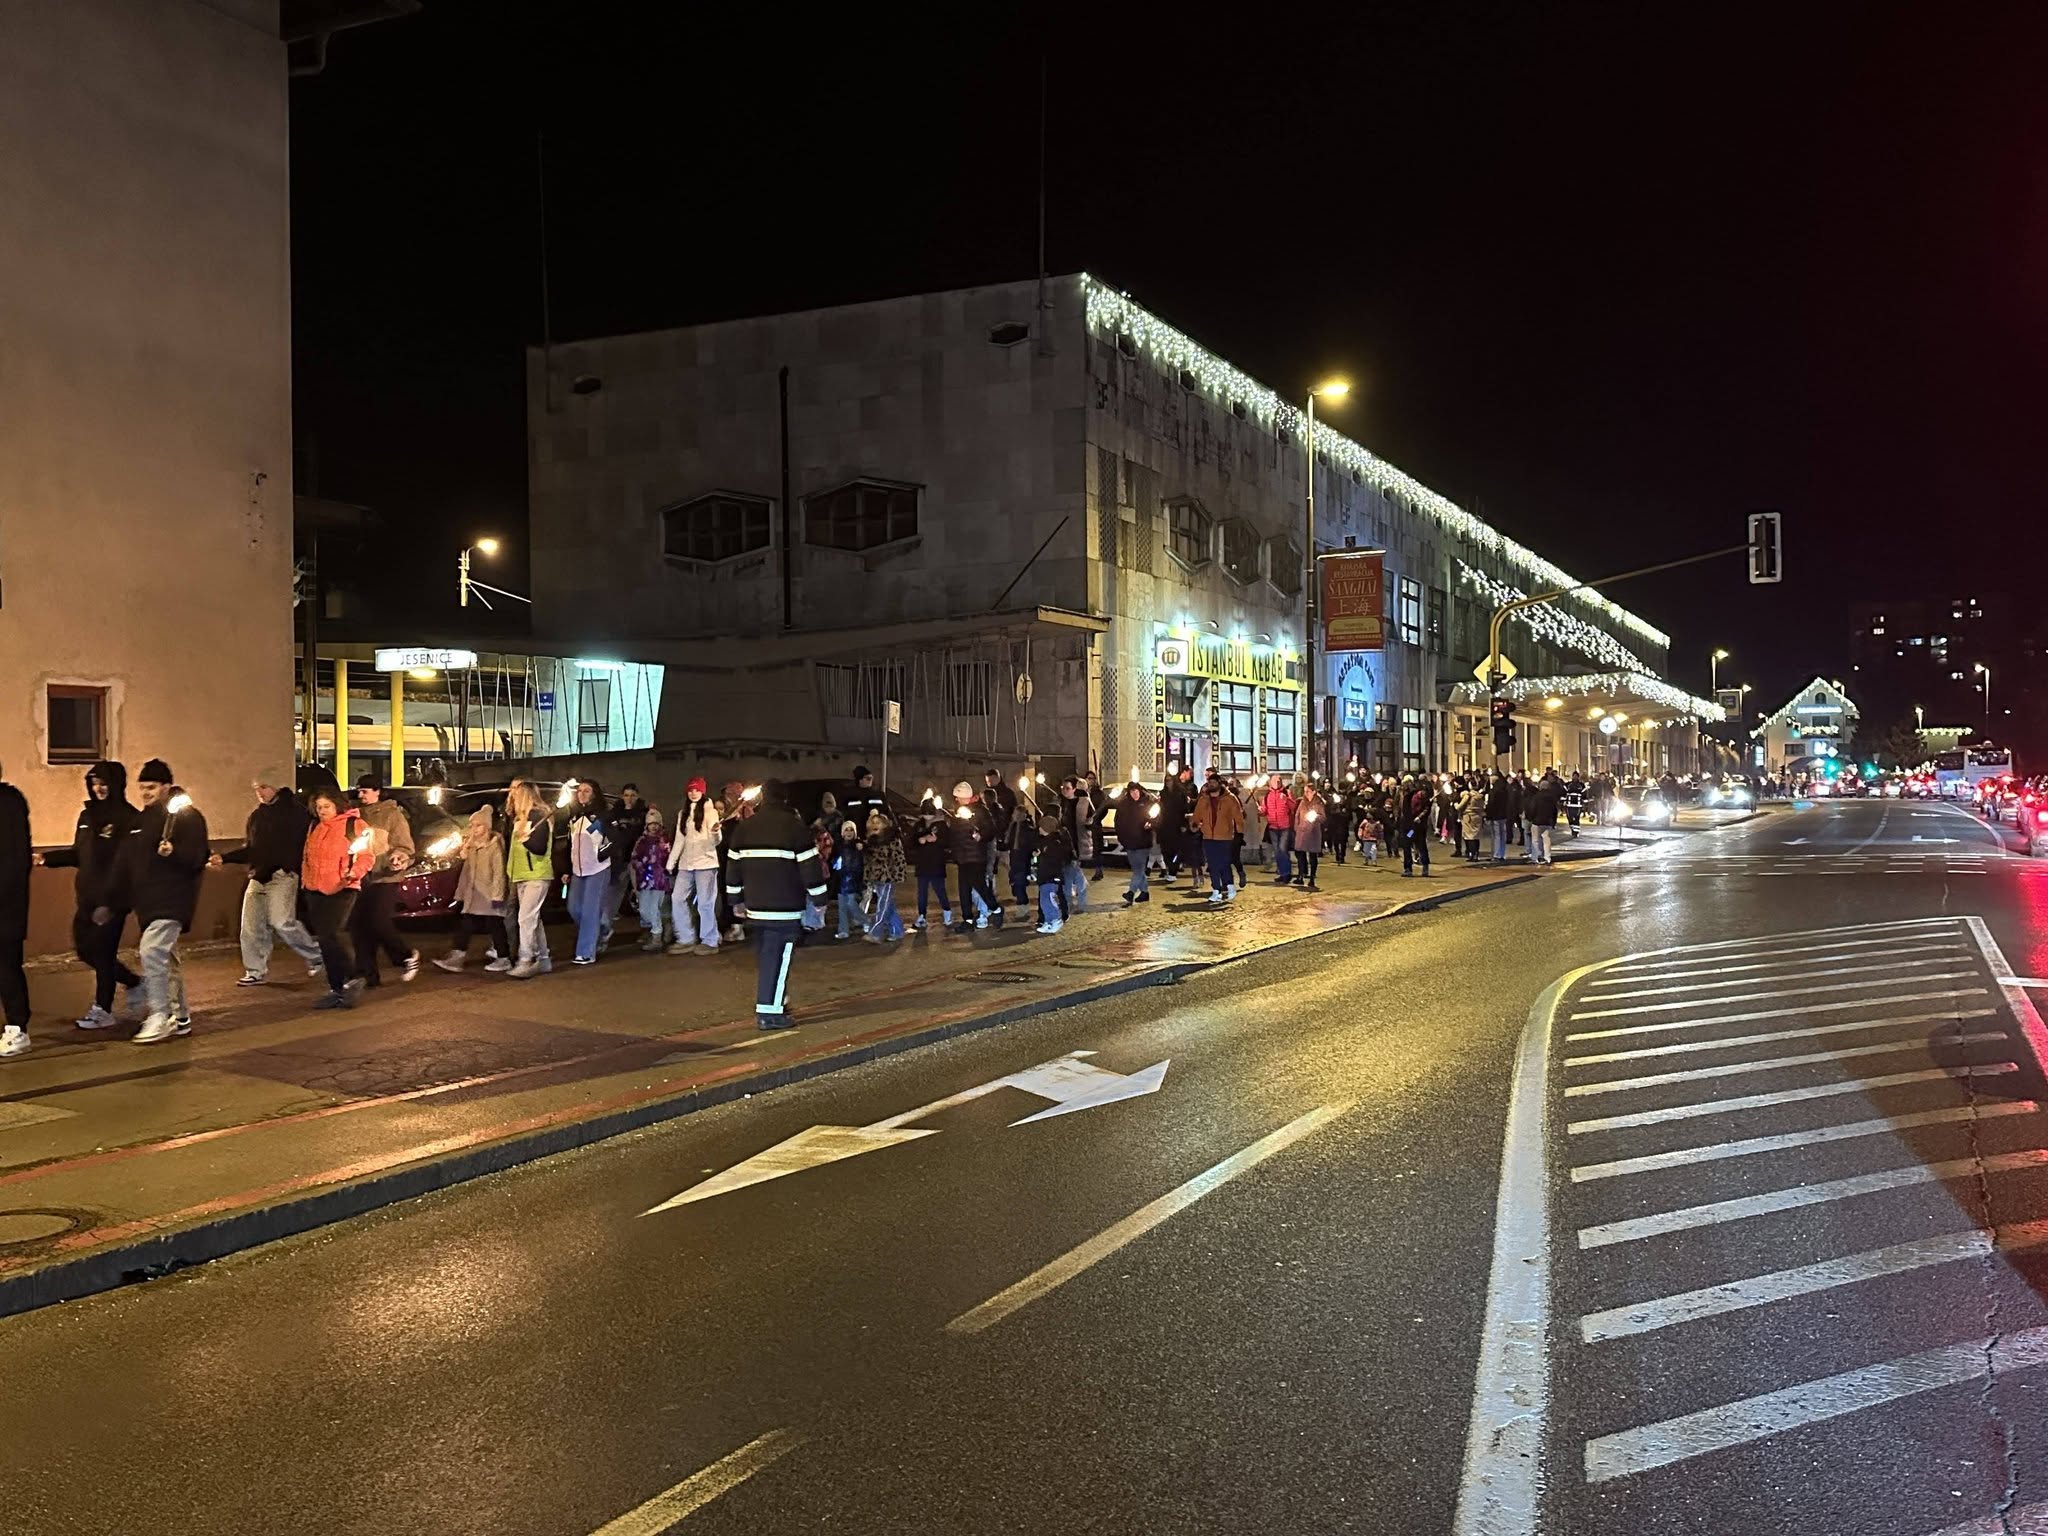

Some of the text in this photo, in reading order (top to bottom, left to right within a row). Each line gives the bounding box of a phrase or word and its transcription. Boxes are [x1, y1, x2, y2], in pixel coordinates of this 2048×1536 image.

[1328, 579, 1377, 596] ŠANGHAI
[1332, 597, 1371, 616] 上海
[401, 653, 453, 665] JESENICE
[1192, 636, 1283, 684] ISTANBUL KEBAB
